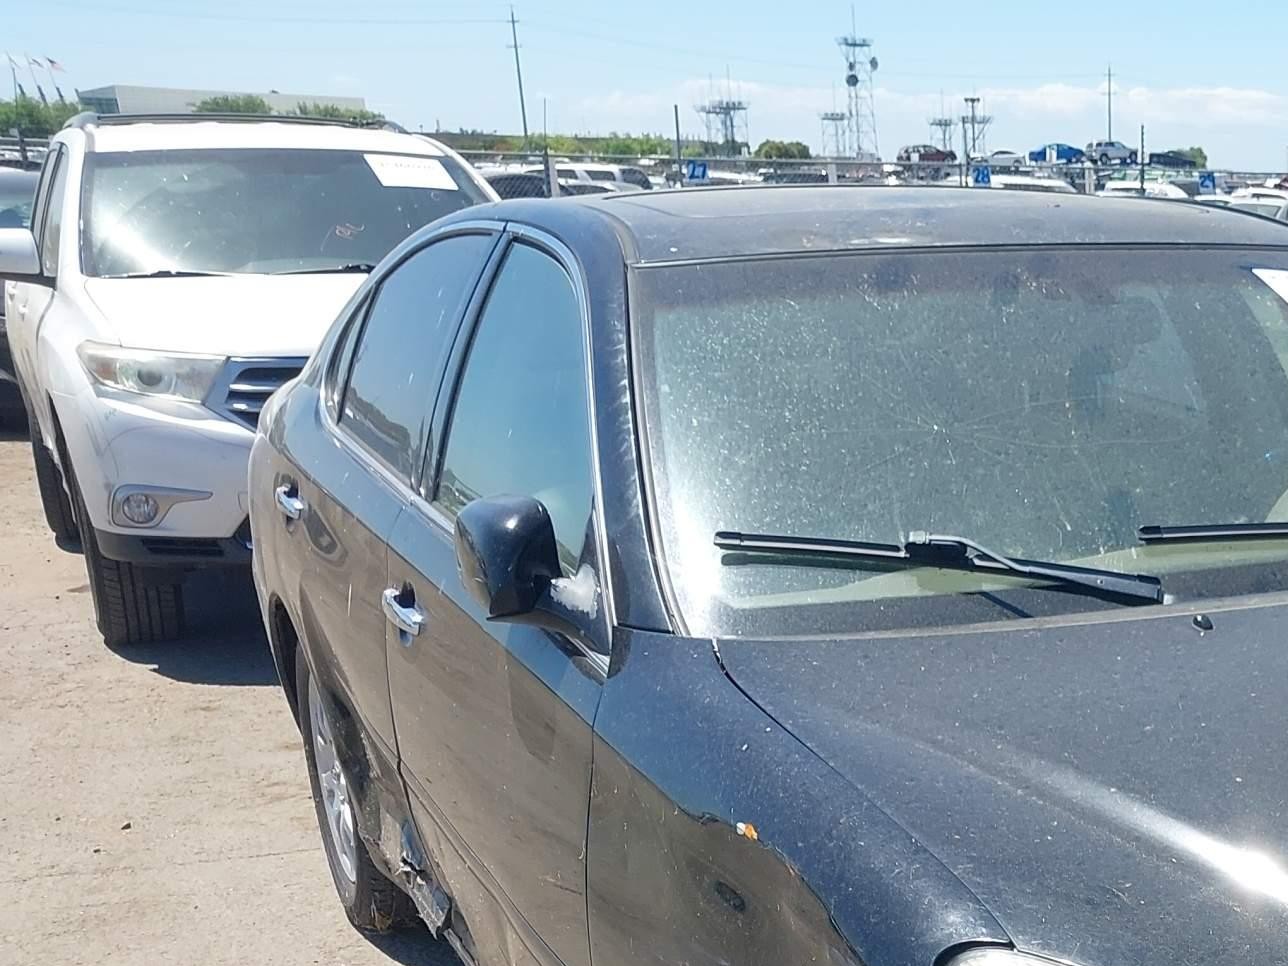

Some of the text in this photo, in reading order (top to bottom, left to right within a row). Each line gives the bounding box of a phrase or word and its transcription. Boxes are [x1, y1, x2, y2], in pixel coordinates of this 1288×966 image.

[687, 160, 708, 181] 27
[973, 166, 991, 184] 28
[1199, 171, 1216, 189] 29
